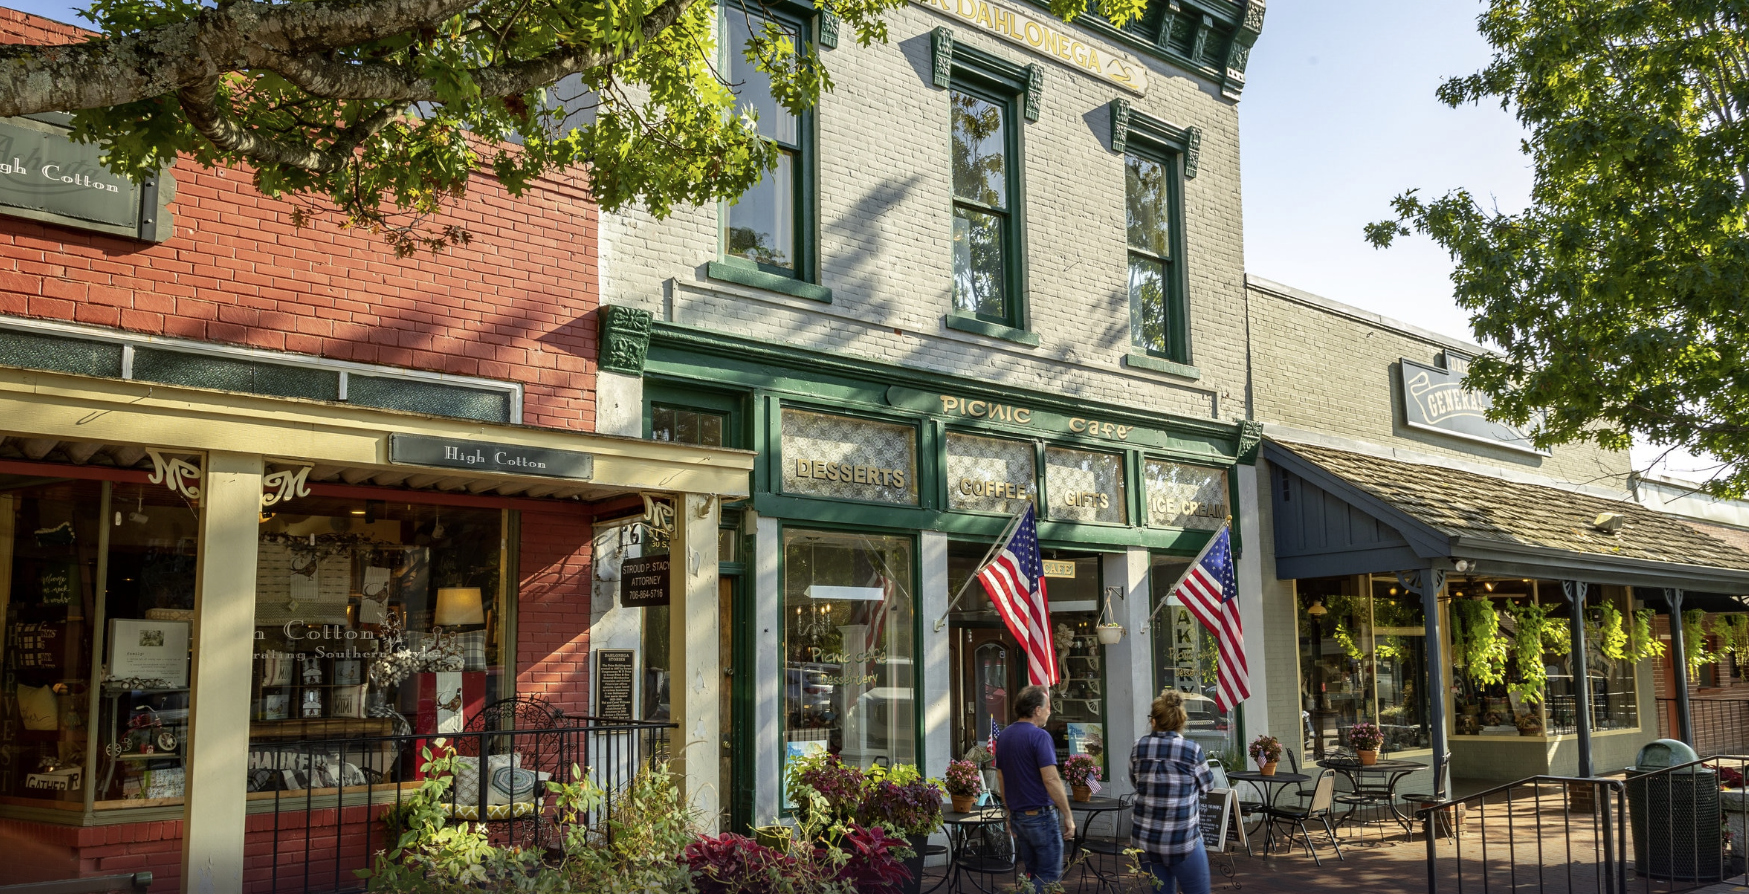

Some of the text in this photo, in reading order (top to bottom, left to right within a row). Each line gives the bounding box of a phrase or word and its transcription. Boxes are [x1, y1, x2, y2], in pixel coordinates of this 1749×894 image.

[956, 0, 1102, 73] DAHLONEGA
[0, 157, 119, 193] gh Cotton
[1427, 388, 1485, 418] GENERAL
[444, 445, 547, 469] High Cotton
[796, 459, 905, 488] DESSERTS
[960, 477, 1027, 500] COFFEE
[1064, 489, 1110, 509] GIFTS
[1151, 497, 1227, 519] ICE CREAM
[622, 563, 646, 575] STROUD
[1043, 563, 1073, 576] CAFE
[631, 575, 662, 587] ATTORNEY
[283, 619, 374, 641] Cotton
[253, 649, 306, 661] rating
[314, 645, 388, 660] Southern
[810, 646, 851, 664] Picnic
[1176, 609, 1194, 694] AKERY
